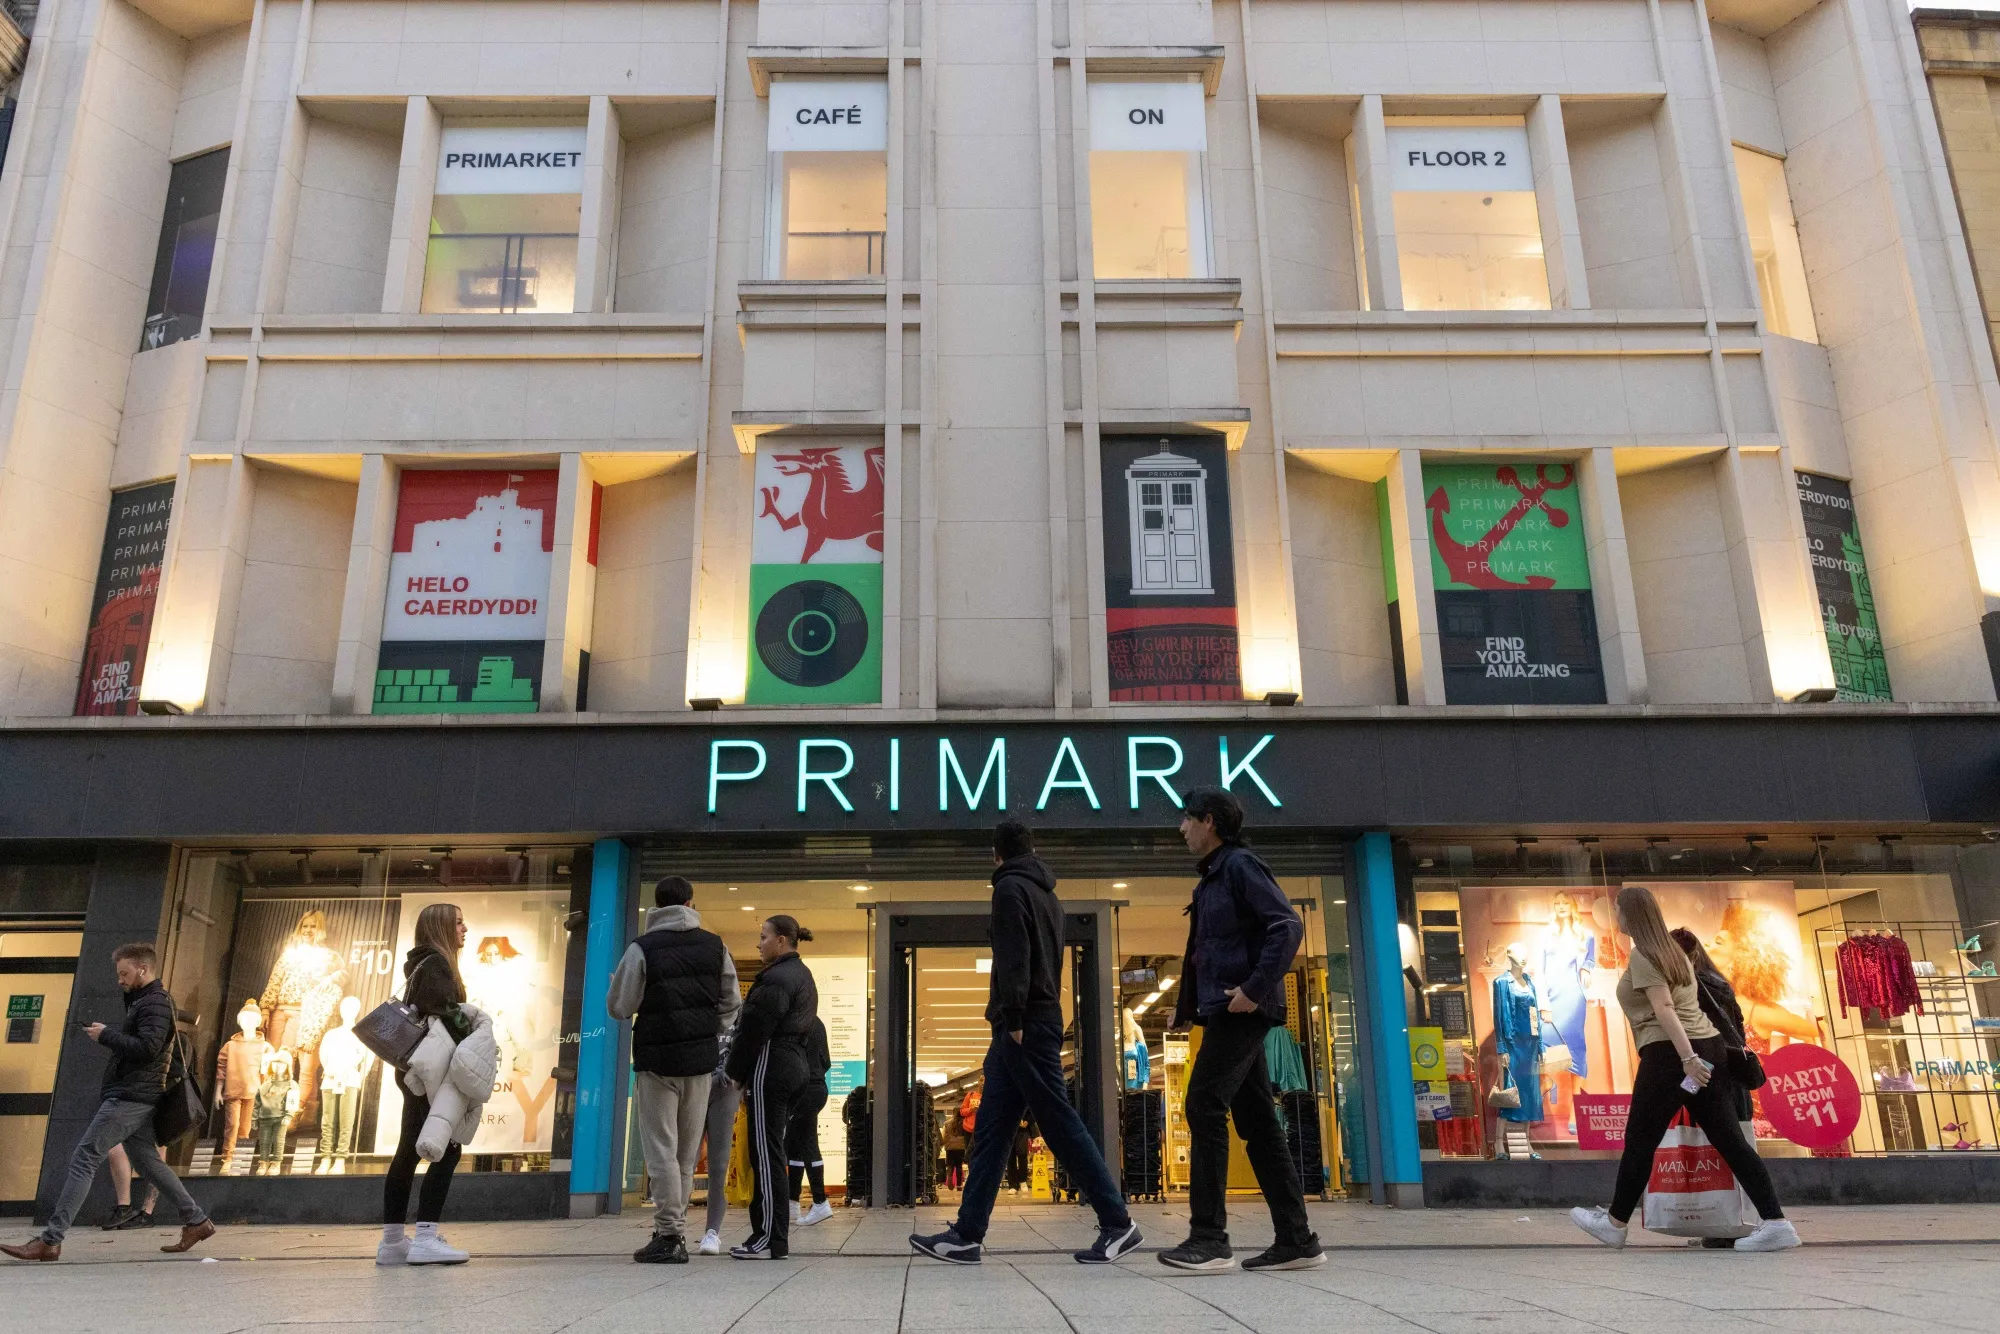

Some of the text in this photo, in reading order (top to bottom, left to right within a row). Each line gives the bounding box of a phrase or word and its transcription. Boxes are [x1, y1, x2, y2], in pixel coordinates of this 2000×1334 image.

[796, 105, 861, 124] CAFÉ
[1129, 109, 1163, 124] ON
[446, 152, 581, 168] PRIMARKET
[1408, 151, 1506, 166] FLOOR 2
[1457, 478, 1544, 490] PRIMARK
[1460, 499, 1548, 510] PRIMARK
[1462, 520, 1550, 531] PRIMARK
[1464, 540, 1553, 552] PRIMARK
[1467, 561, 1556, 573] PRIMARK
[407, 576, 469, 593] HELO
[404, 599, 538, 615] CAERDYDD!
[1485, 637, 1525, 651] FIND
[1476, 650, 1527, 664] YOUR
[101, 661, 130, 678] FIND
[1485, 664, 1570, 678] AMAZ!NG
[92, 675, 128, 693] YOUR
[706, 733, 1282, 814] PRIMARK
[349, 949, 393, 975] £10
[1767, 1064, 1838, 1095] PARTY
[1787, 1086, 1835, 1107] FROM
[1580, 1105, 1607, 1115] THE
[1793, 1101, 1839, 1127] £11
[1591, 1118, 1628, 1128] WORS
[1657, 1158, 1721, 1173] MATALAN
